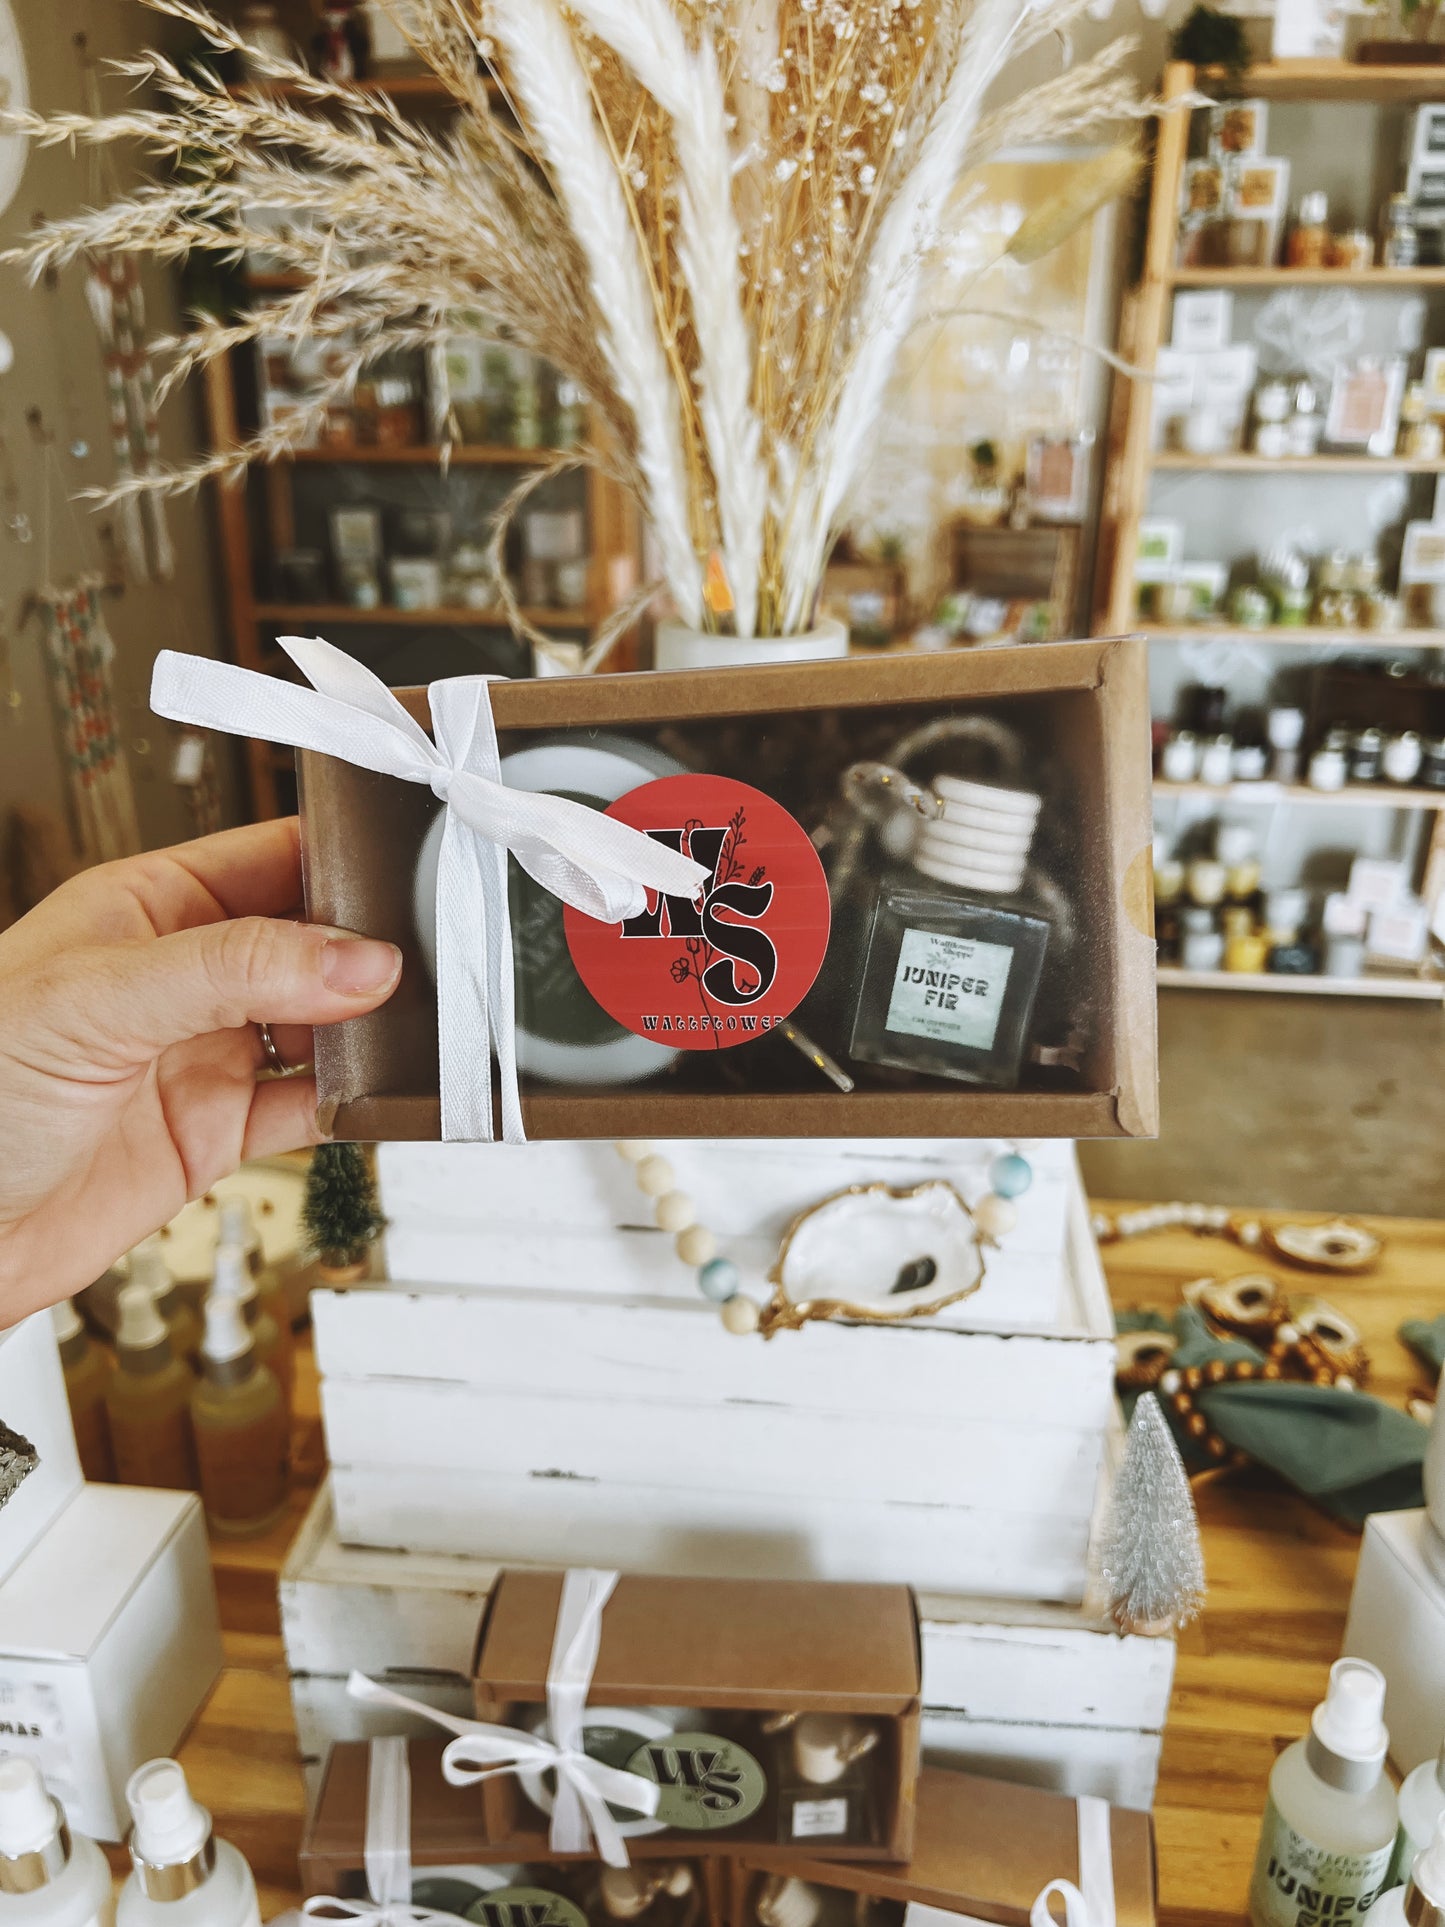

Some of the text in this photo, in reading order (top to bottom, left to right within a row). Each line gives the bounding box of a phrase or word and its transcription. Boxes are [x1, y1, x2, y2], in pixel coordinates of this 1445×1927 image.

[903, 966, 989, 997] JUNIPER
[924, 989, 959, 1010] FIR
[1266, 1854, 1384, 1917] JUNIPE
[478, 1902, 572, 1927] W
